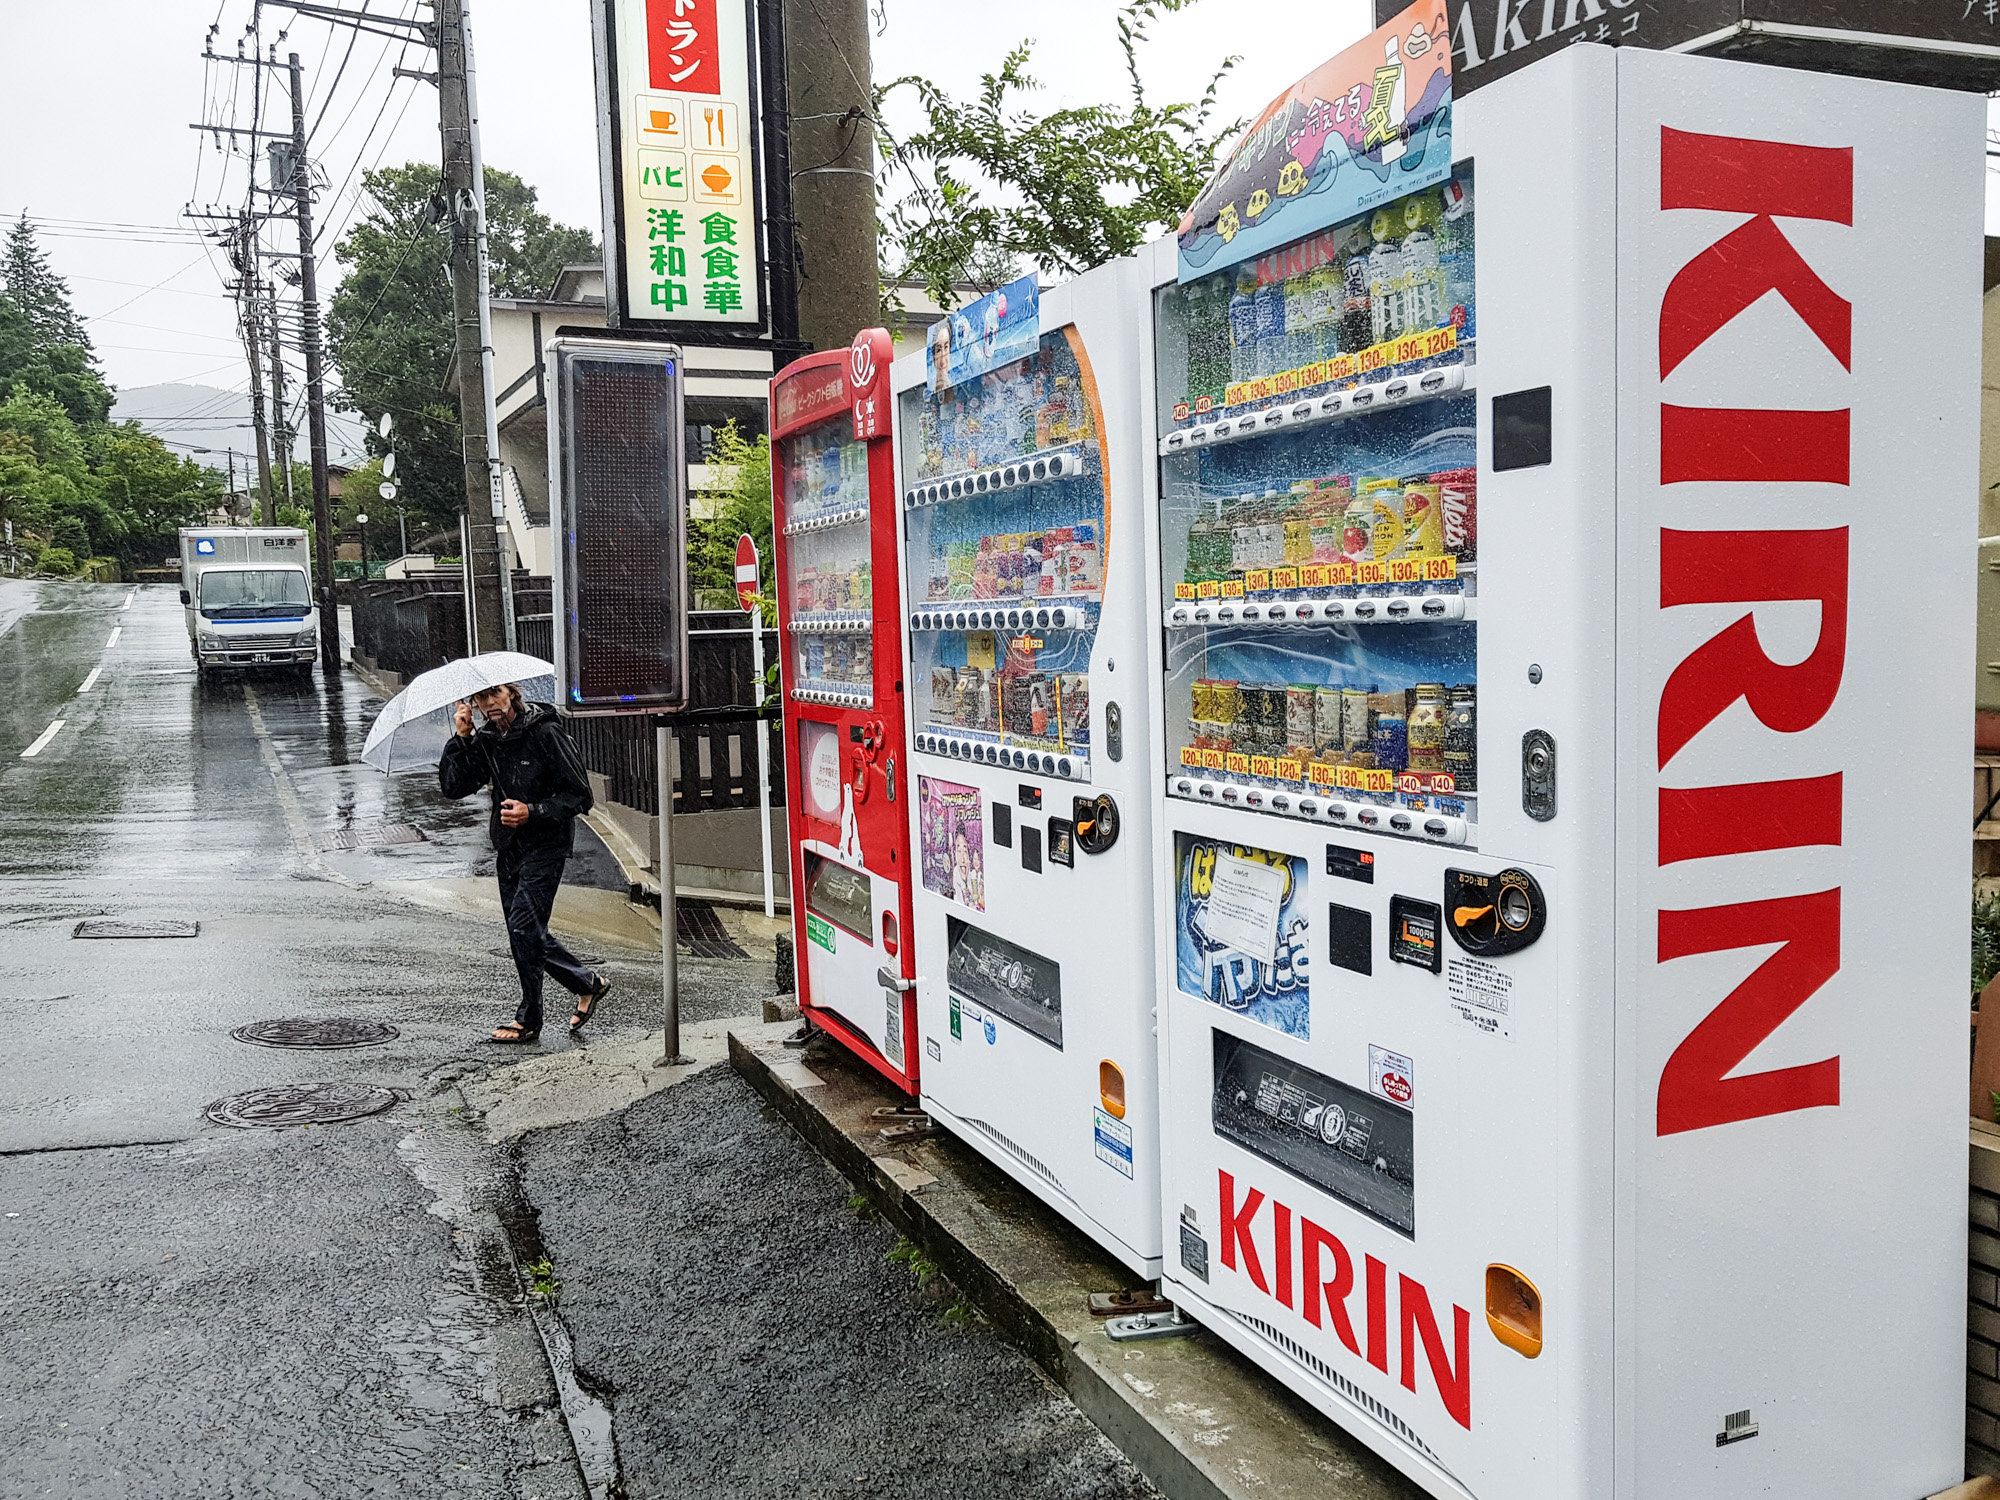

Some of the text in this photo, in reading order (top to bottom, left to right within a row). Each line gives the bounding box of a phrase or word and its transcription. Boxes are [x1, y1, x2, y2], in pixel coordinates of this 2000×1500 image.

[1256, 228, 1335, 287] KIRIN
[1657, 125, 1853, 1136] KIRIN
[1466, 970, 1513, 988] 0465-82-8110
[1218, 1168, 1470, 1432] KIRIN
